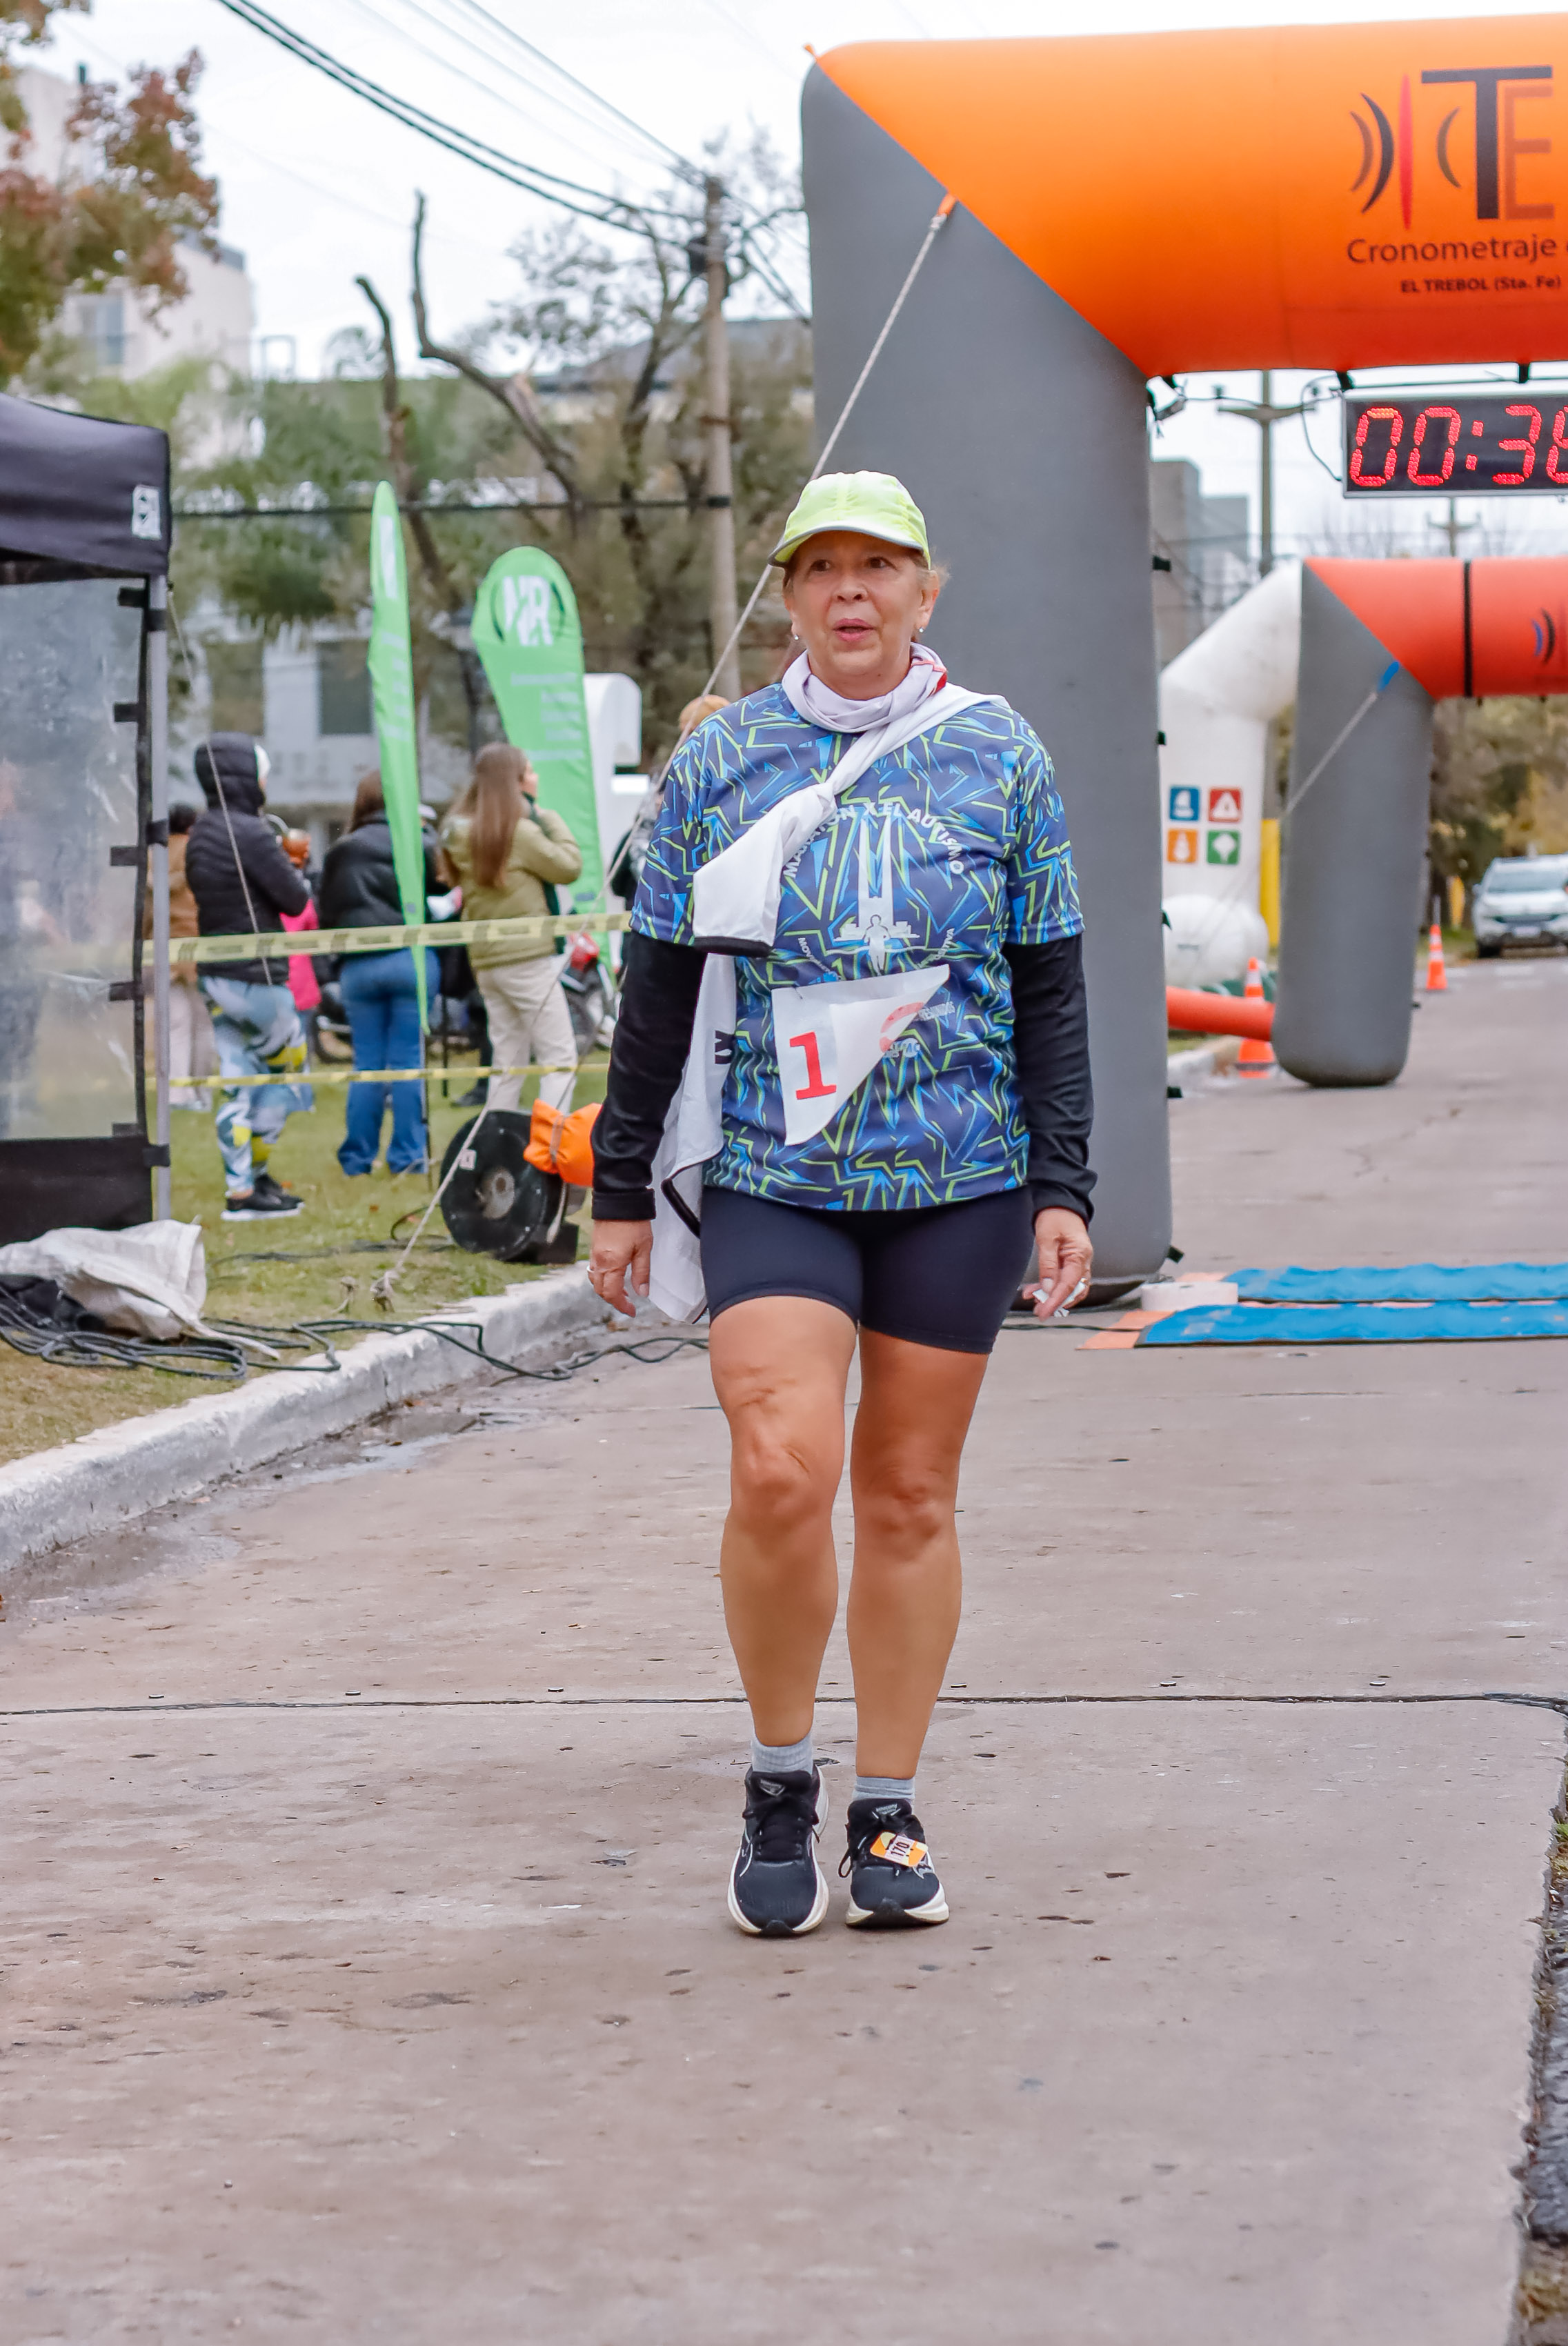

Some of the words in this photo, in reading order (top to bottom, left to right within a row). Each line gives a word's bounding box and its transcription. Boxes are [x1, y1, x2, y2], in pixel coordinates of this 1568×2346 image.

[1347, 233, 1556, 264] Cronometraje
[1400, 279, 1419, 292] EL
[1424, 277, 1488, 292] TREBOL
[863, 802, 876, 816] X
[883, 802, 902, 817] EL
[906, 808, 964, 875] AUTISMO
[891, 1842, 909, 1856] 170
